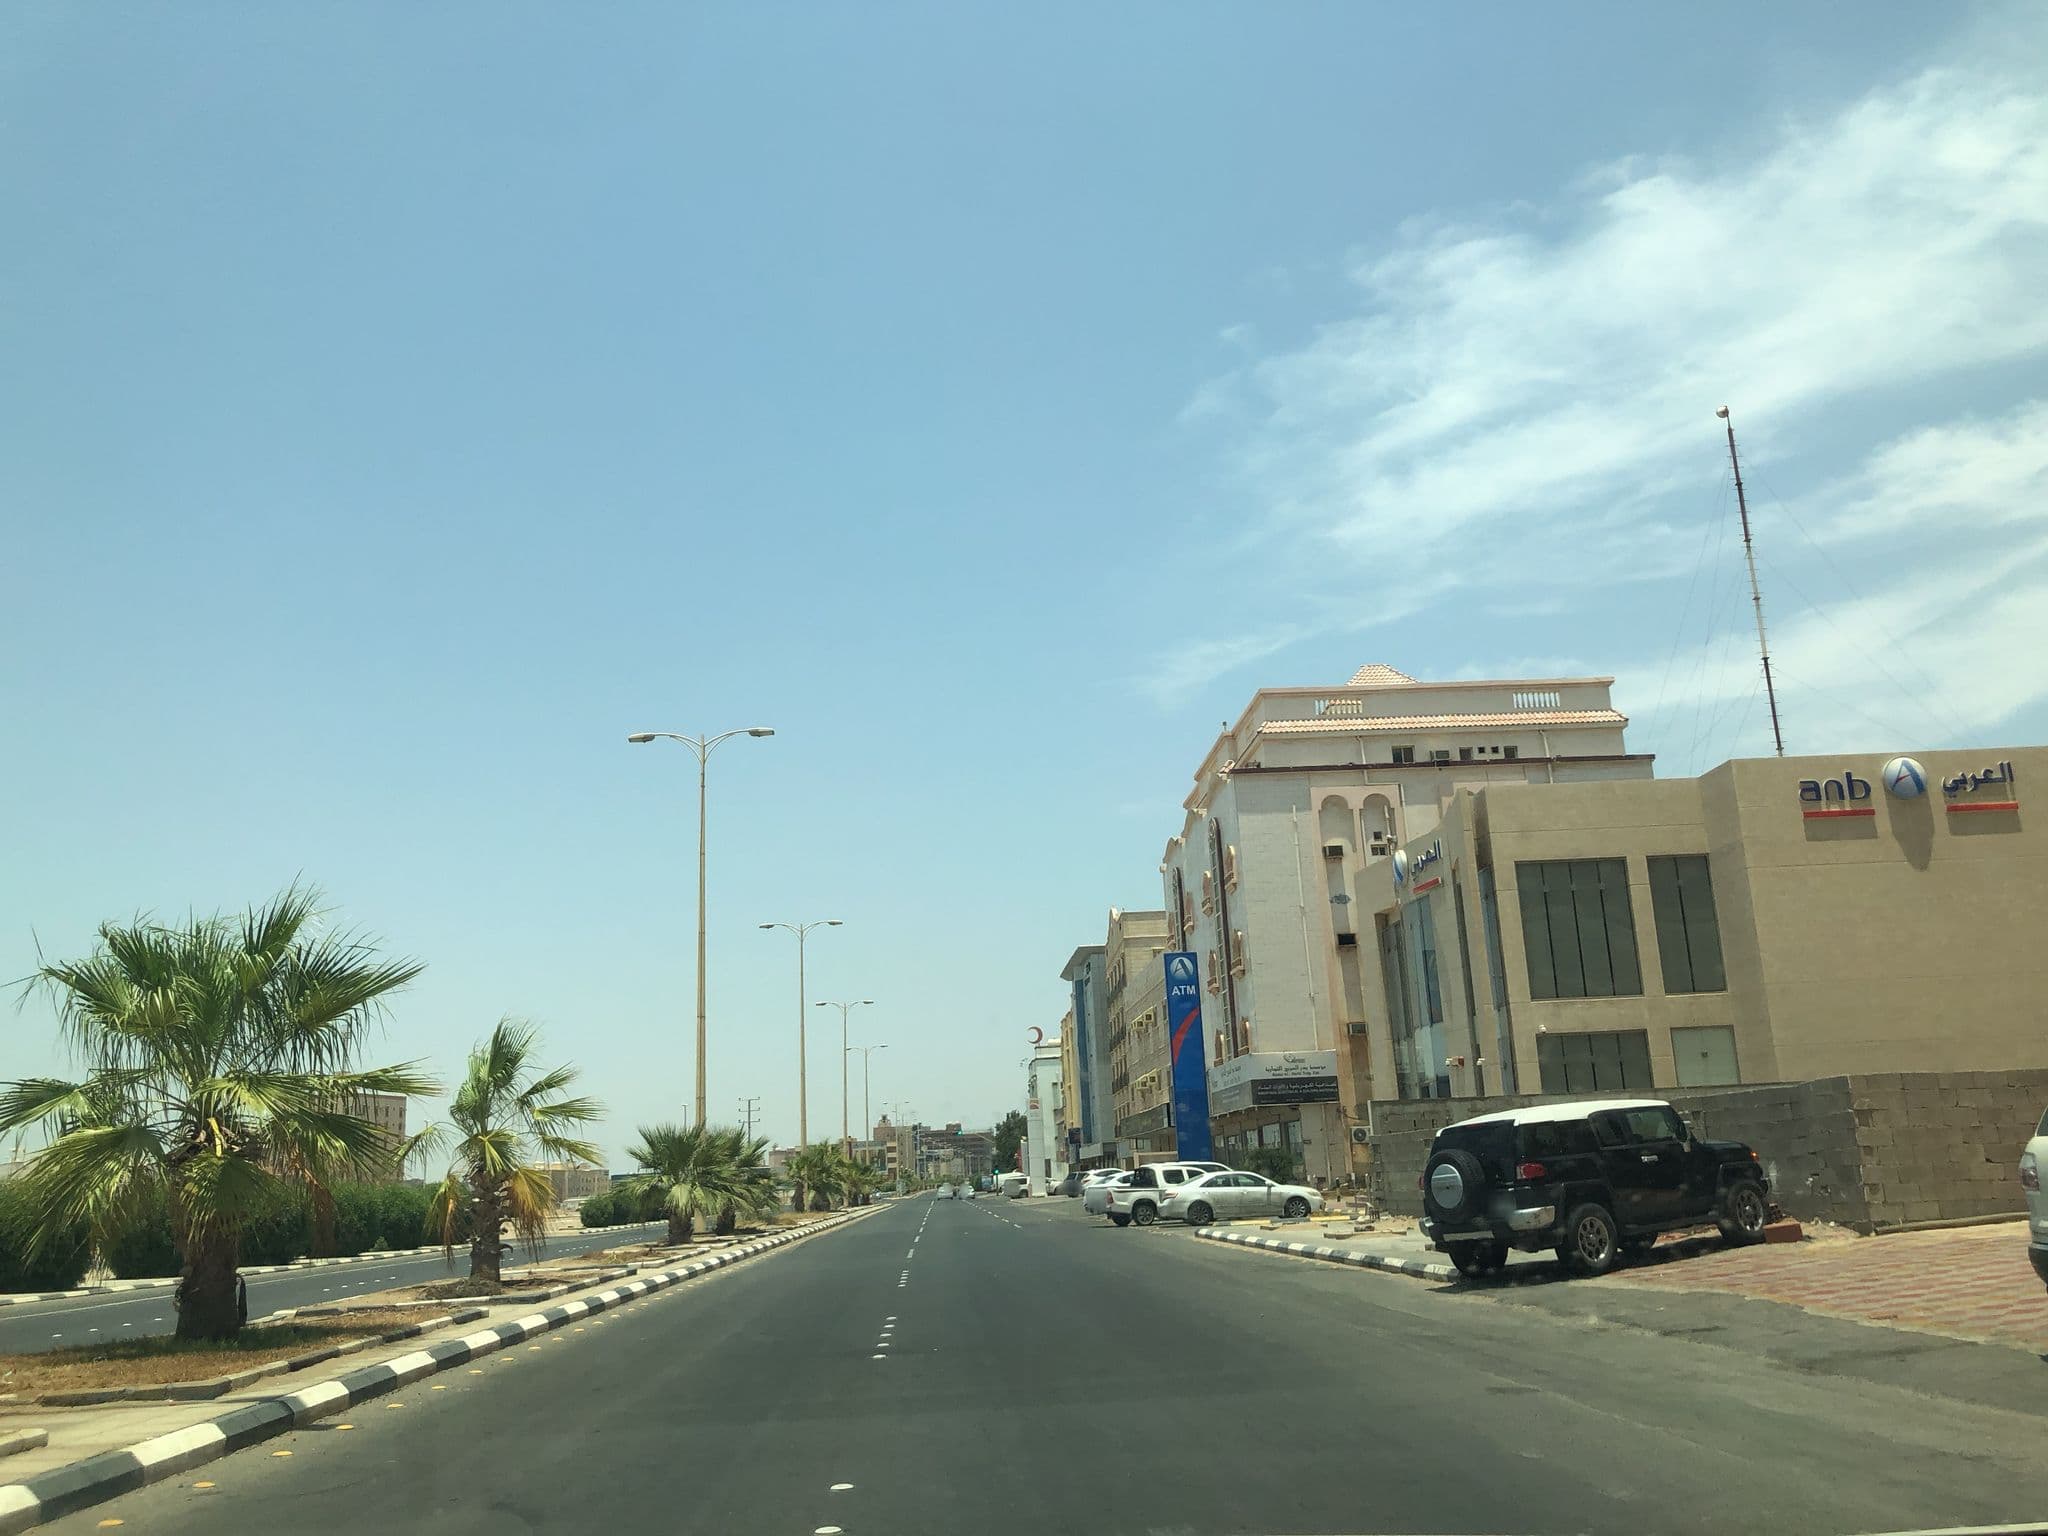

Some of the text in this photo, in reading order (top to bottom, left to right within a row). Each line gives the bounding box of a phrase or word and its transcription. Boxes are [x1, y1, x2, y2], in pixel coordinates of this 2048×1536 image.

[1799, 770, 1872, 801] anb
[1941, 760, 2015, 798] العربي
[1171, 985, 1196, 996] ATM
